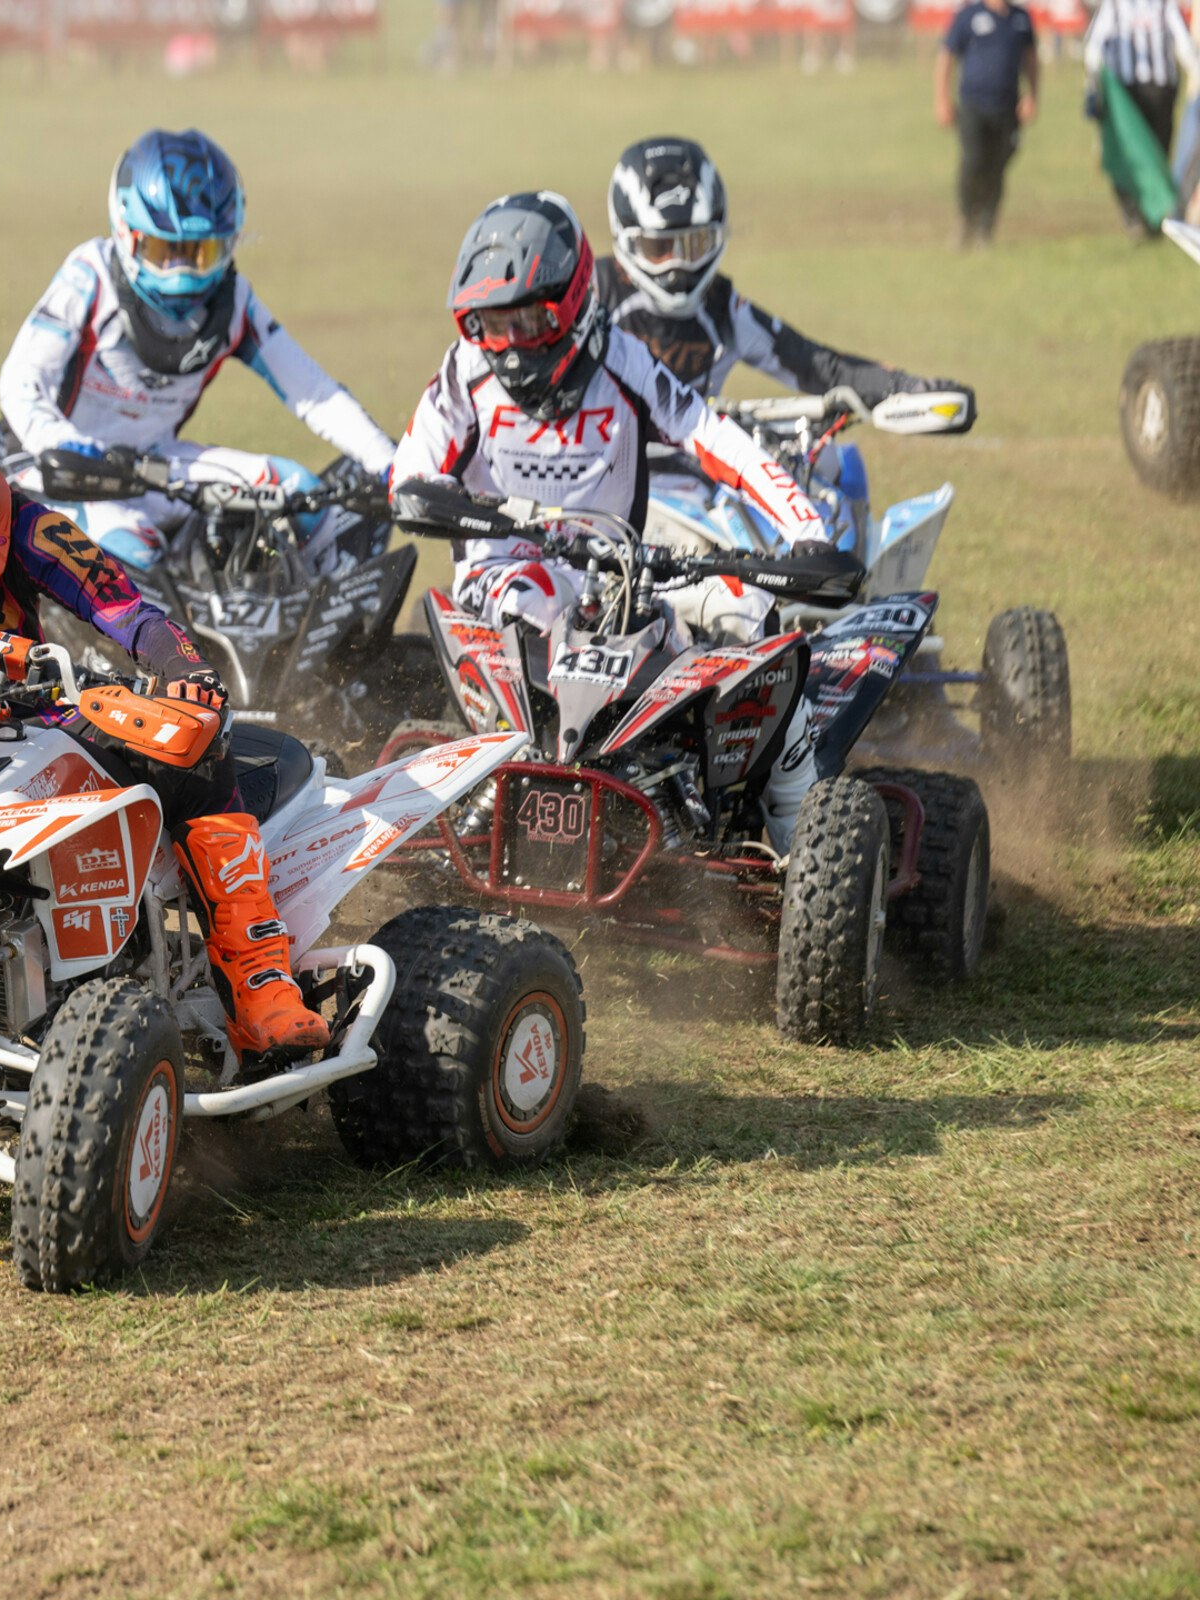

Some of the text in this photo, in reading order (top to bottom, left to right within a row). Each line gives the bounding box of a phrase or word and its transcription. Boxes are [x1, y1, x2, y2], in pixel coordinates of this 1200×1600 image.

[488, 405, 615, 446] FXR
[557, 649, 630, 678] 430
[152, 722, 181, 745] 1
[516, 790, 586, 839] 430
[80, 878, 126, 894] KENDA
[530, 1022, 550, 1080] KENDA
[153, 1095, 161, 1180] KENDA
